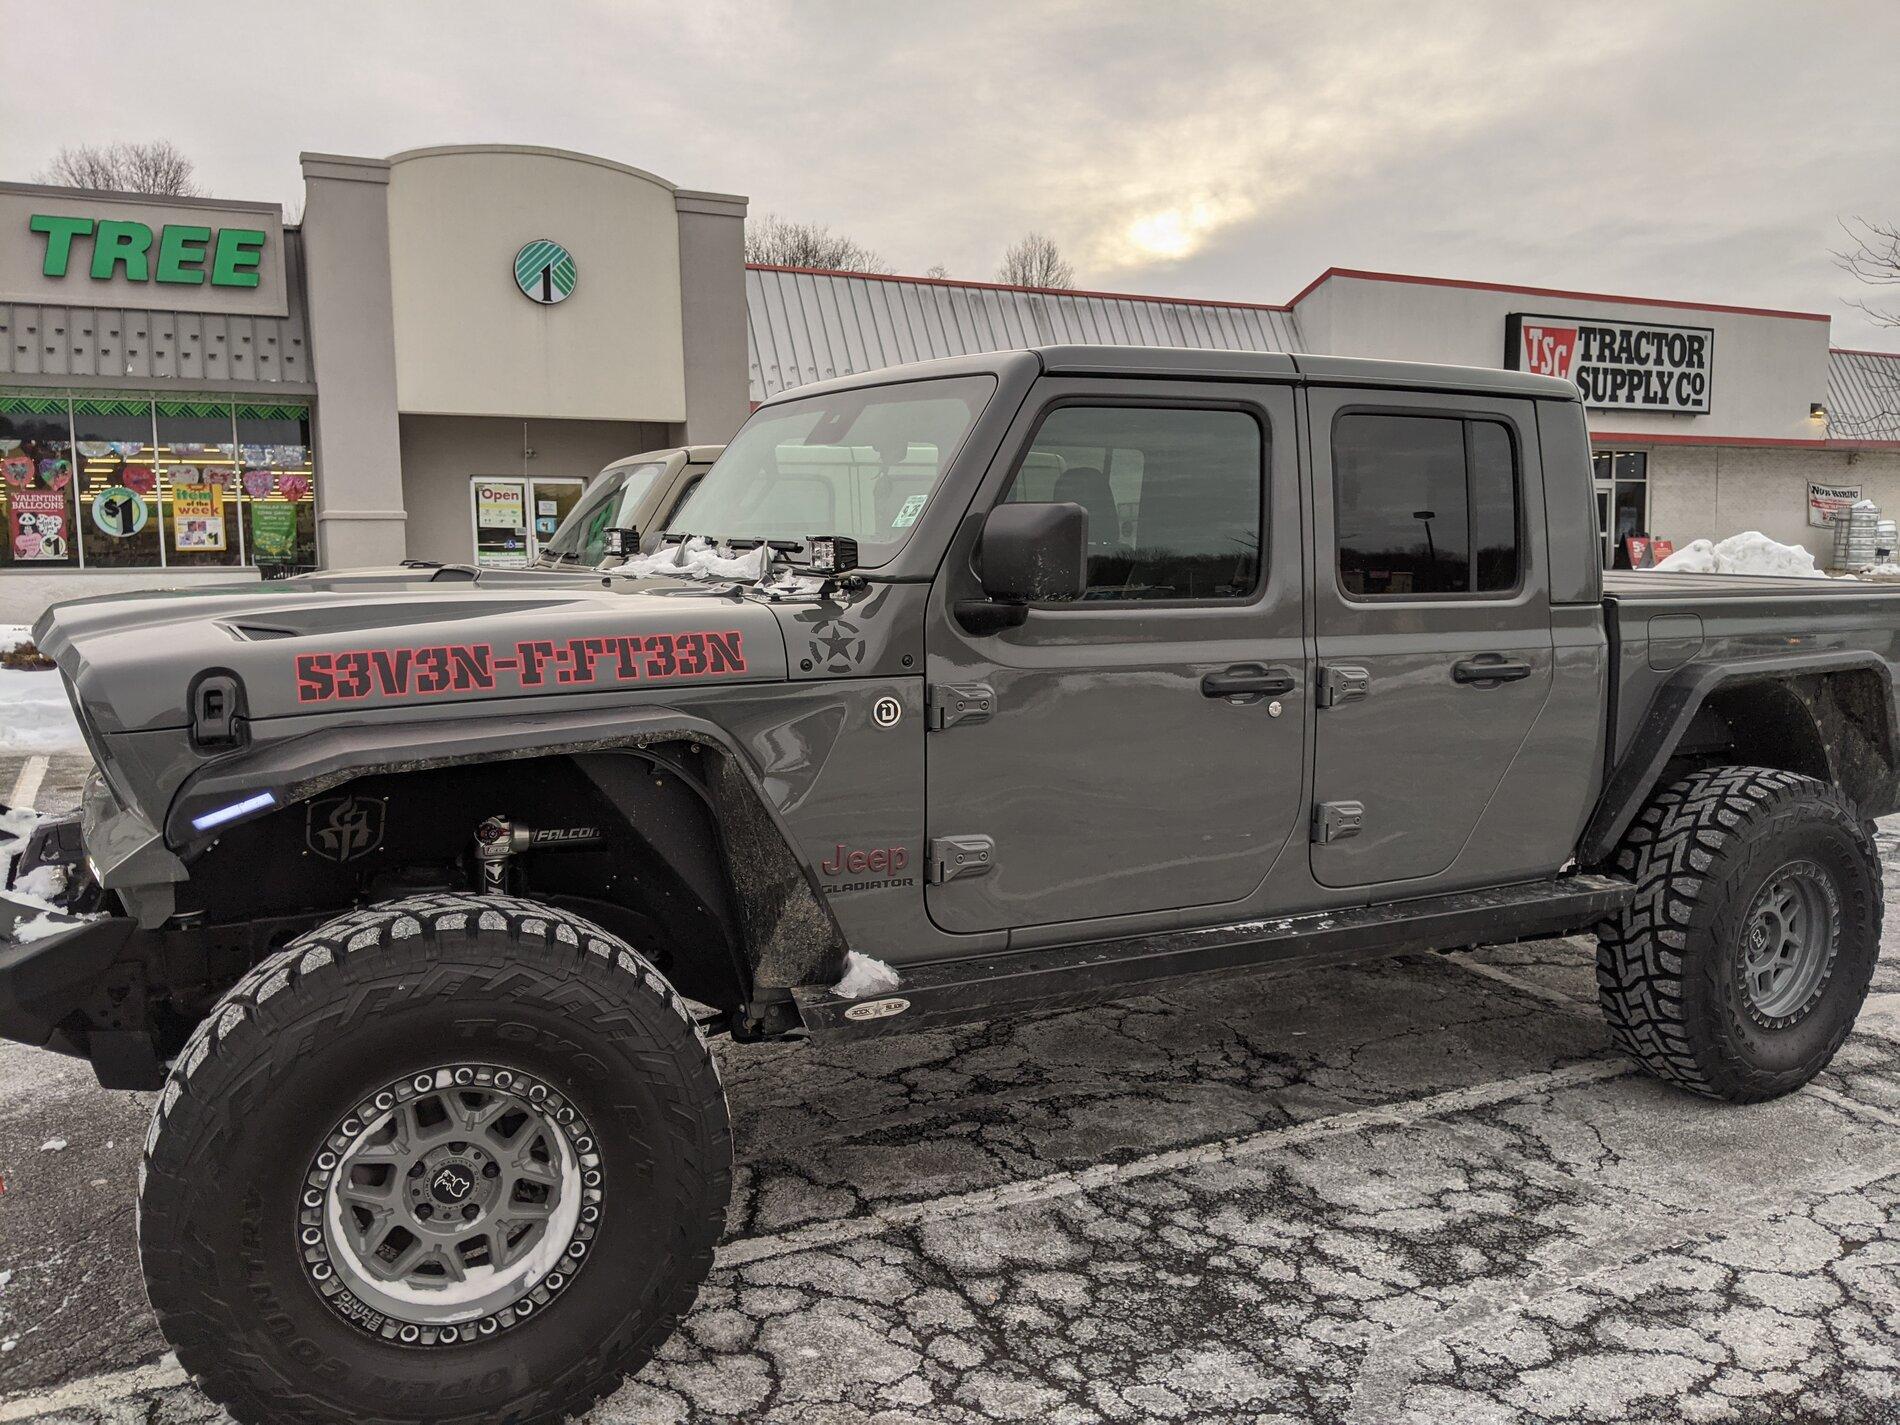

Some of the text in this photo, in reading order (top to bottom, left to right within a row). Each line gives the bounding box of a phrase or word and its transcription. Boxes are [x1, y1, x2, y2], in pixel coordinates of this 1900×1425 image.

[30, 214, 266, 288] TREE
[1529, 328, 1567, 379] TSC
[1578, 326, 1705, 369] TRACTOR
[1576, 365, 1674, 405] SUPPLY
[12, 501, 64, 509] BALLOONS
[14, 494, 64, 502] VALENTINE
[176, 488, 213, 500] item
[482, 488, 519, 502] Open
[103, 497, 135, 535] $1
[536, 827, 600, 841] FALCON
[822, 844, 910, 877] Jeep
[821, 878, 914, 894] GLADIATOR
[332, 1294, 380, 1332] BLACK
[340, 1290, 385, 1325] RHINO
